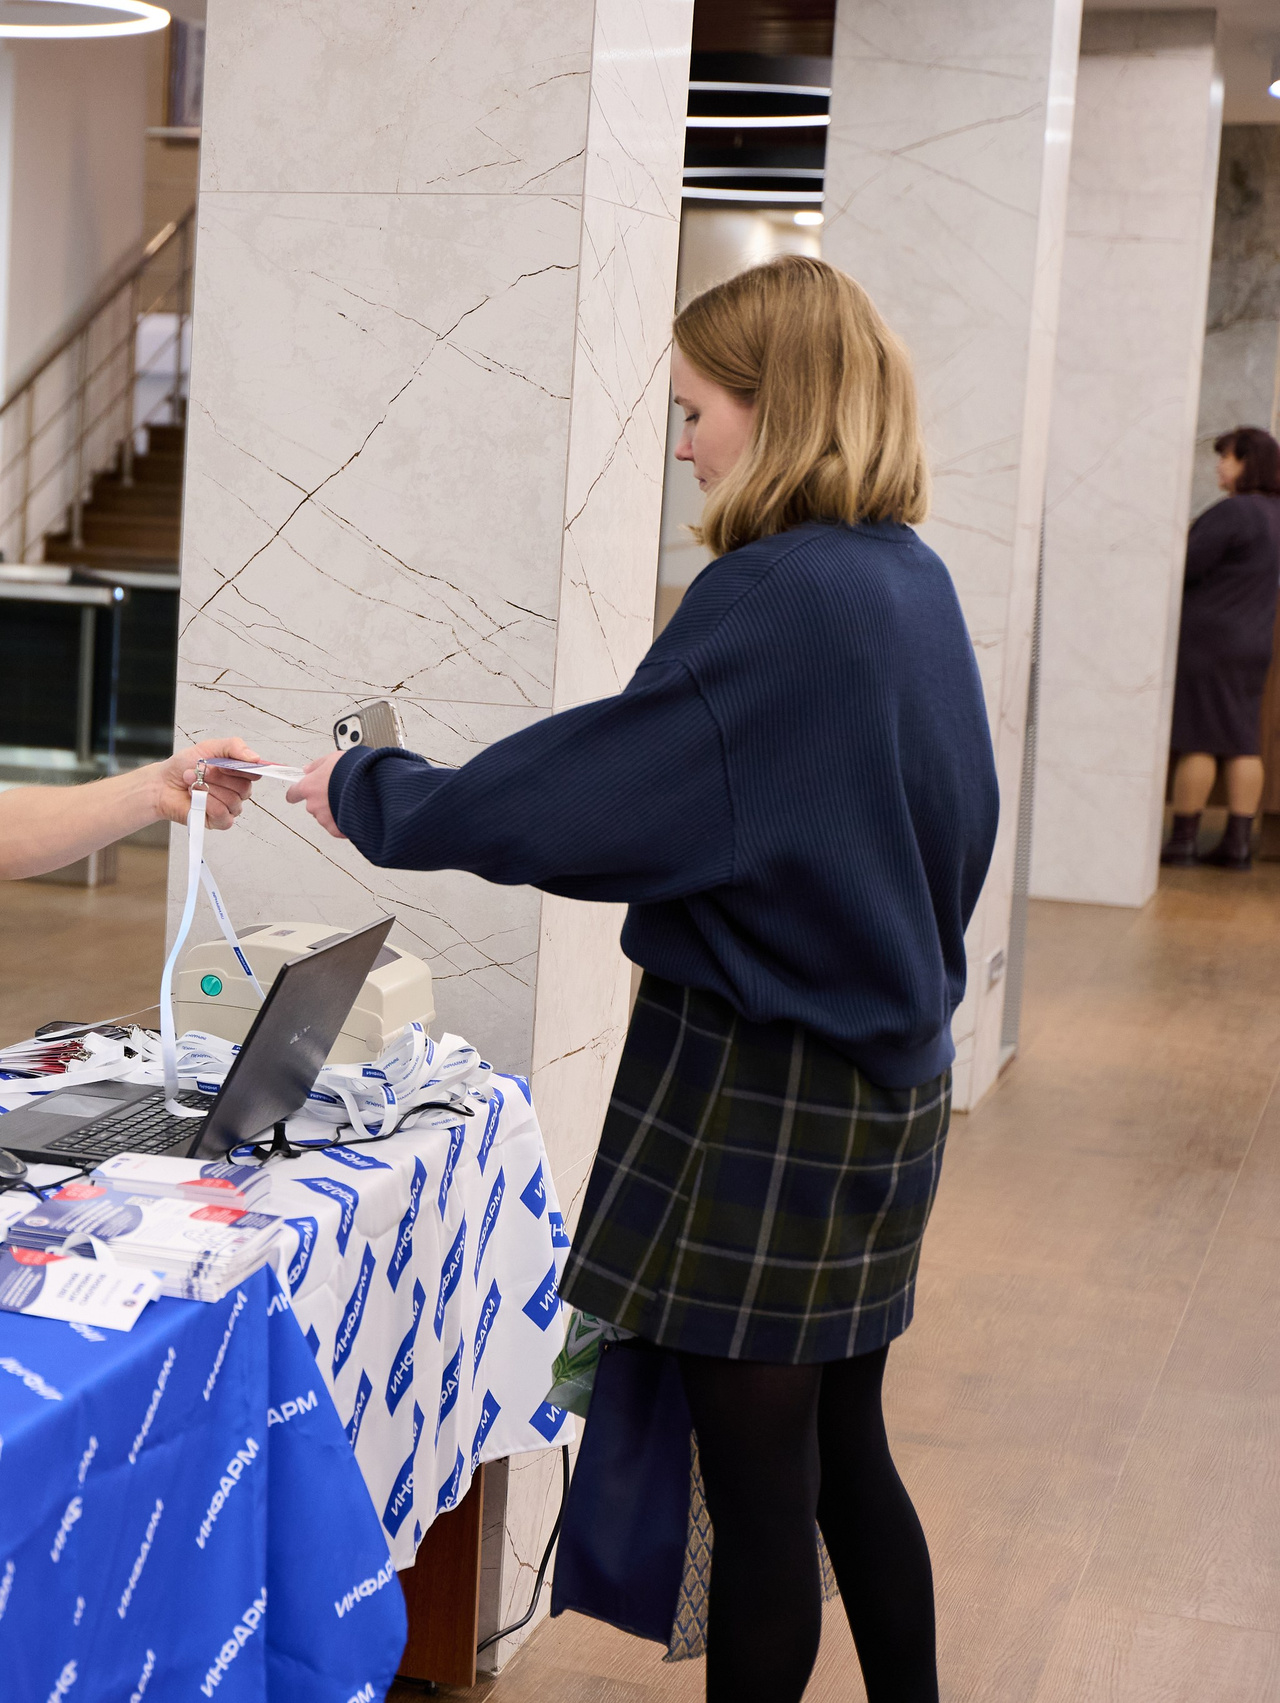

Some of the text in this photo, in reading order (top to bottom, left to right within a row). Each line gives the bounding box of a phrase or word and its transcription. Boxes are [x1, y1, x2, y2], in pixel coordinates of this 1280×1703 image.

[443, 1059, 469, 1070] INPHARM.RU
[442, 1126, 463, 1200] ИНФАР
[288, 1220, 314, 1285] ФАРМ
[333, 1264, 370, 1363] ИНФАРМ
[266, 1389, 319, 1428] АРМ
[349, 1391, 366, 1448] АРМ
[195, 1437, 261, 1550] ИНФАРМ
[200, 1586, 268, 1698] ИНФАРМ
